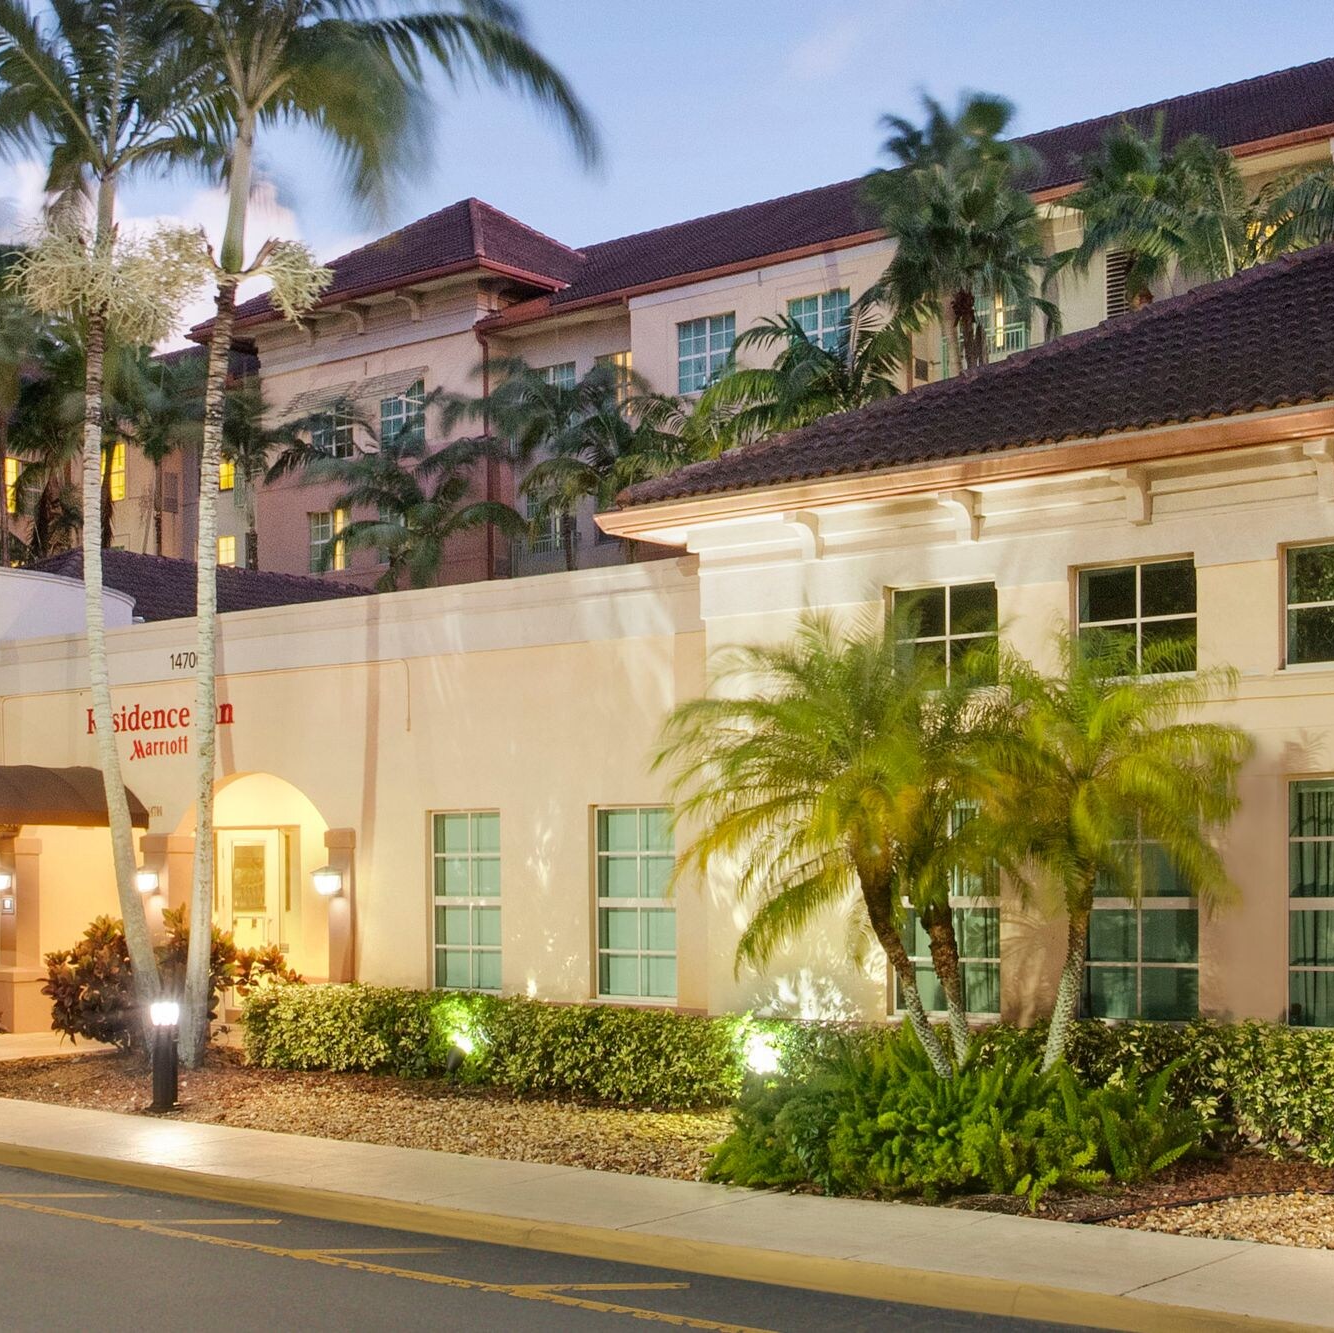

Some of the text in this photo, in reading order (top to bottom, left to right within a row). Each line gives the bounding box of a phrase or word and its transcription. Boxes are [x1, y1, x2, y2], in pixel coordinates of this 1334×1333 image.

[170, 651, 199, 671] 1470
[86, 703, 190, 735] Rsidence
[129, 735, 188, 761] Marriott
